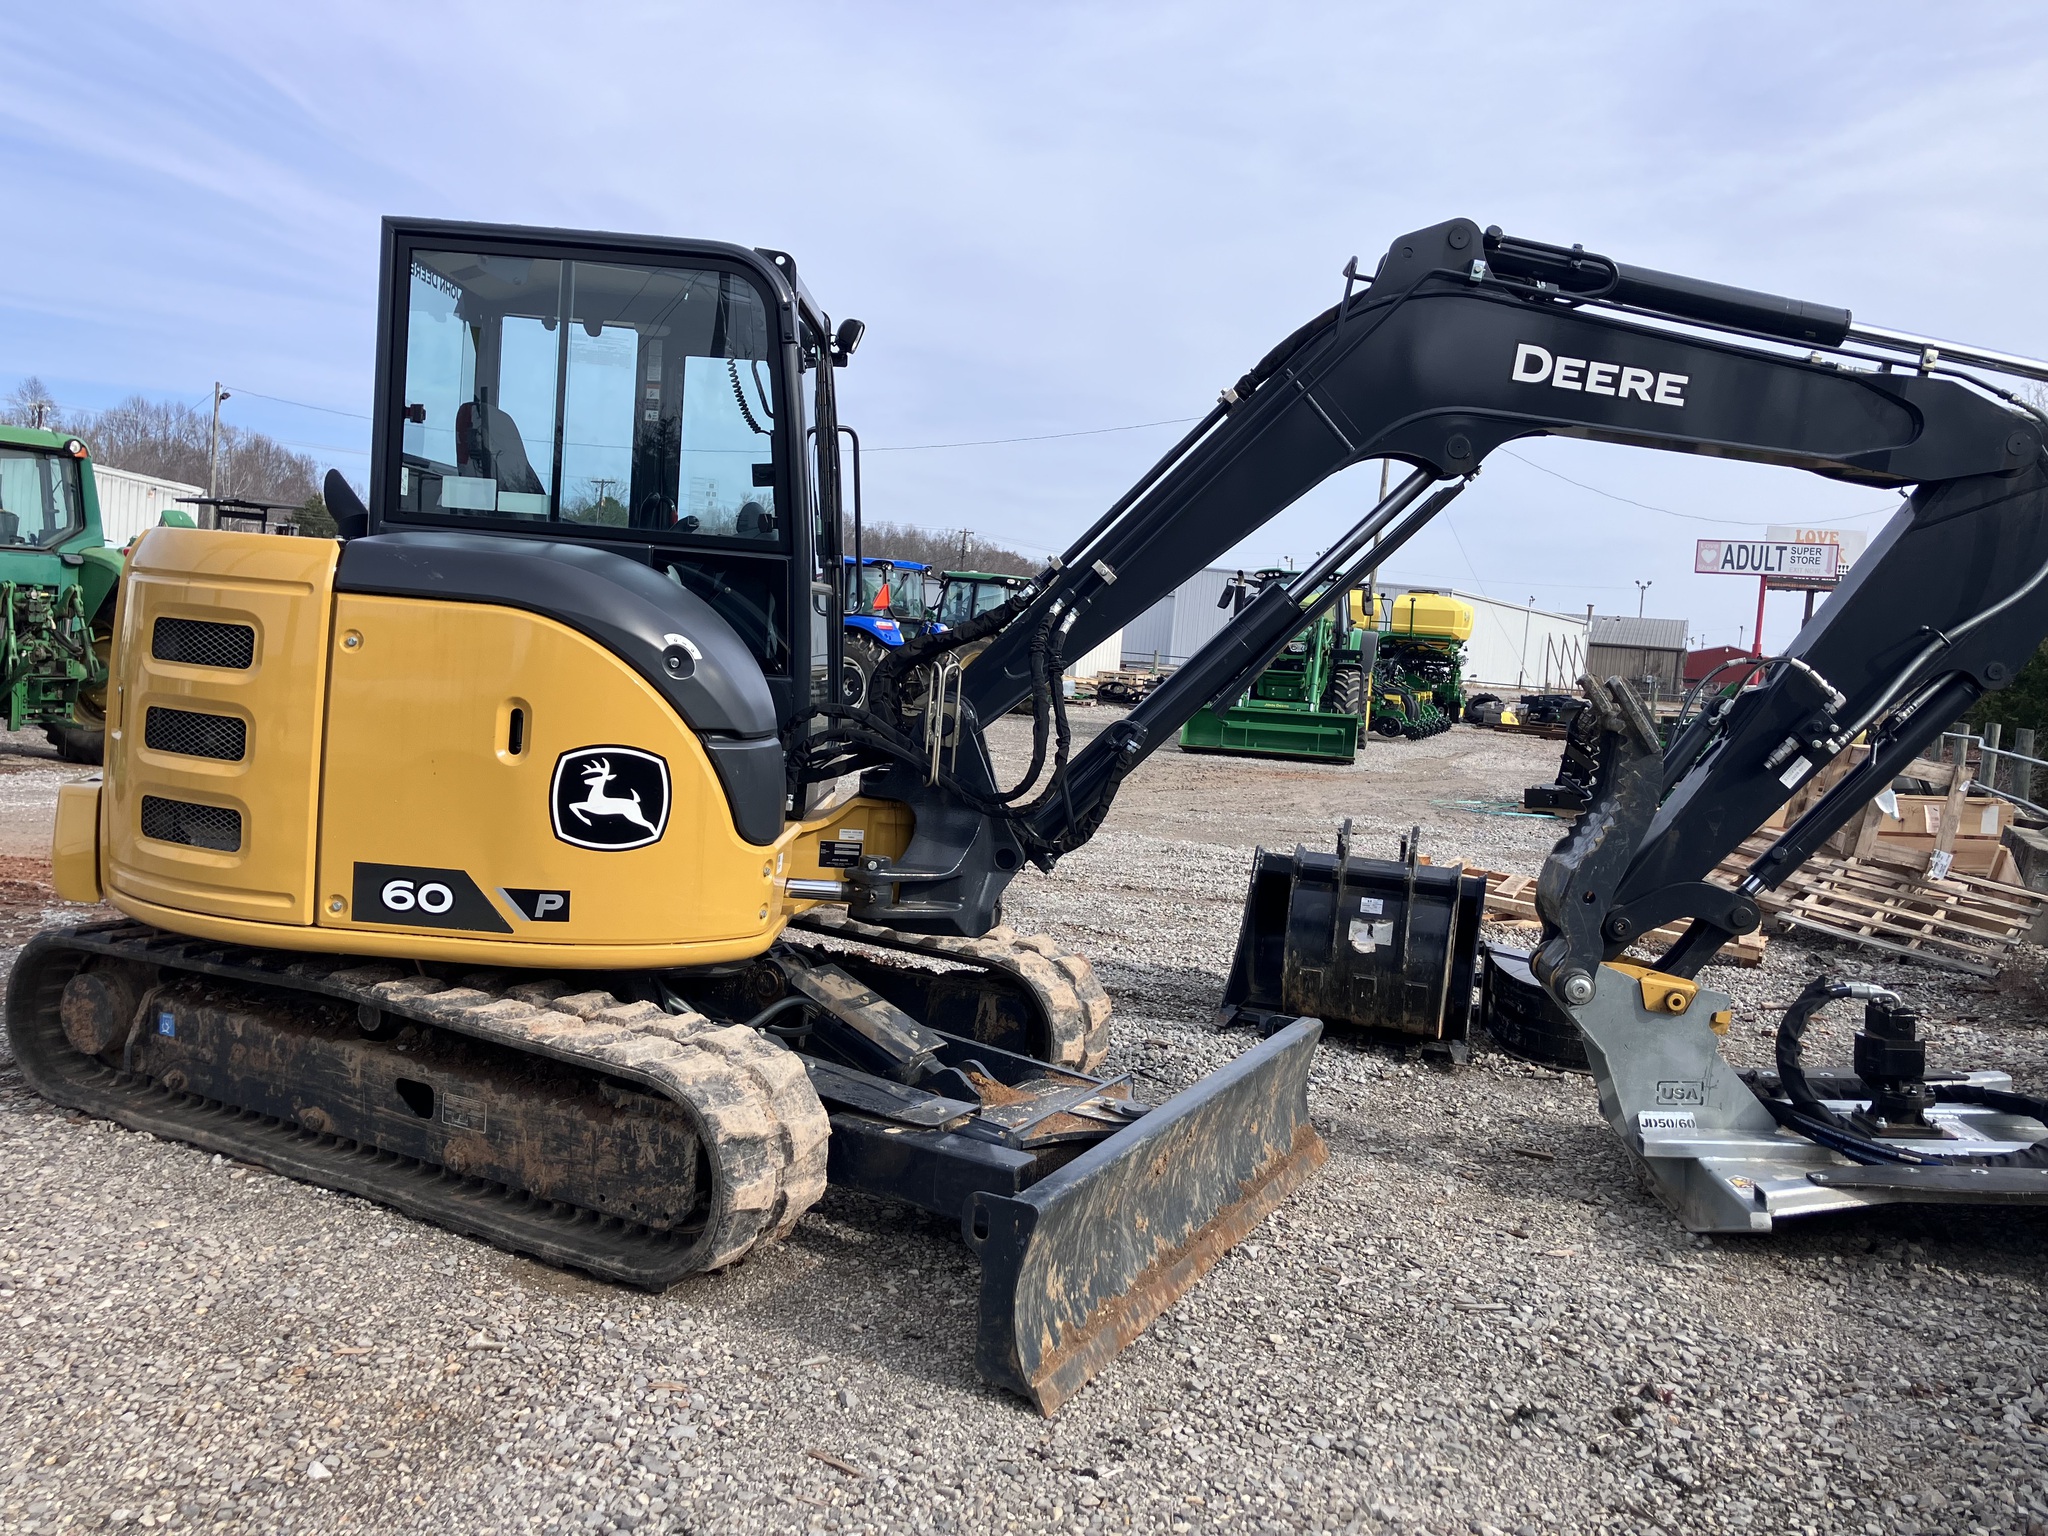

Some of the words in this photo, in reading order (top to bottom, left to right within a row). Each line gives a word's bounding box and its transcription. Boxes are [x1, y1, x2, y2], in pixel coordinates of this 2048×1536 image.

[1512, 343, 1689, 406] DEERE
[1795, 529, 1840, 545] LOVE
[1721, 544, 1788, 572] ADULT
[1790, 546, 1822, 556] SUPER
[1789, 556, 1821, 565] STORE
[381, 879, 455, 914] 60
[534, 893, 564, 918] P
[1661, 1087, 1698, 1100] USA
[1641, 1118, 1697, 1129] JD50/60
